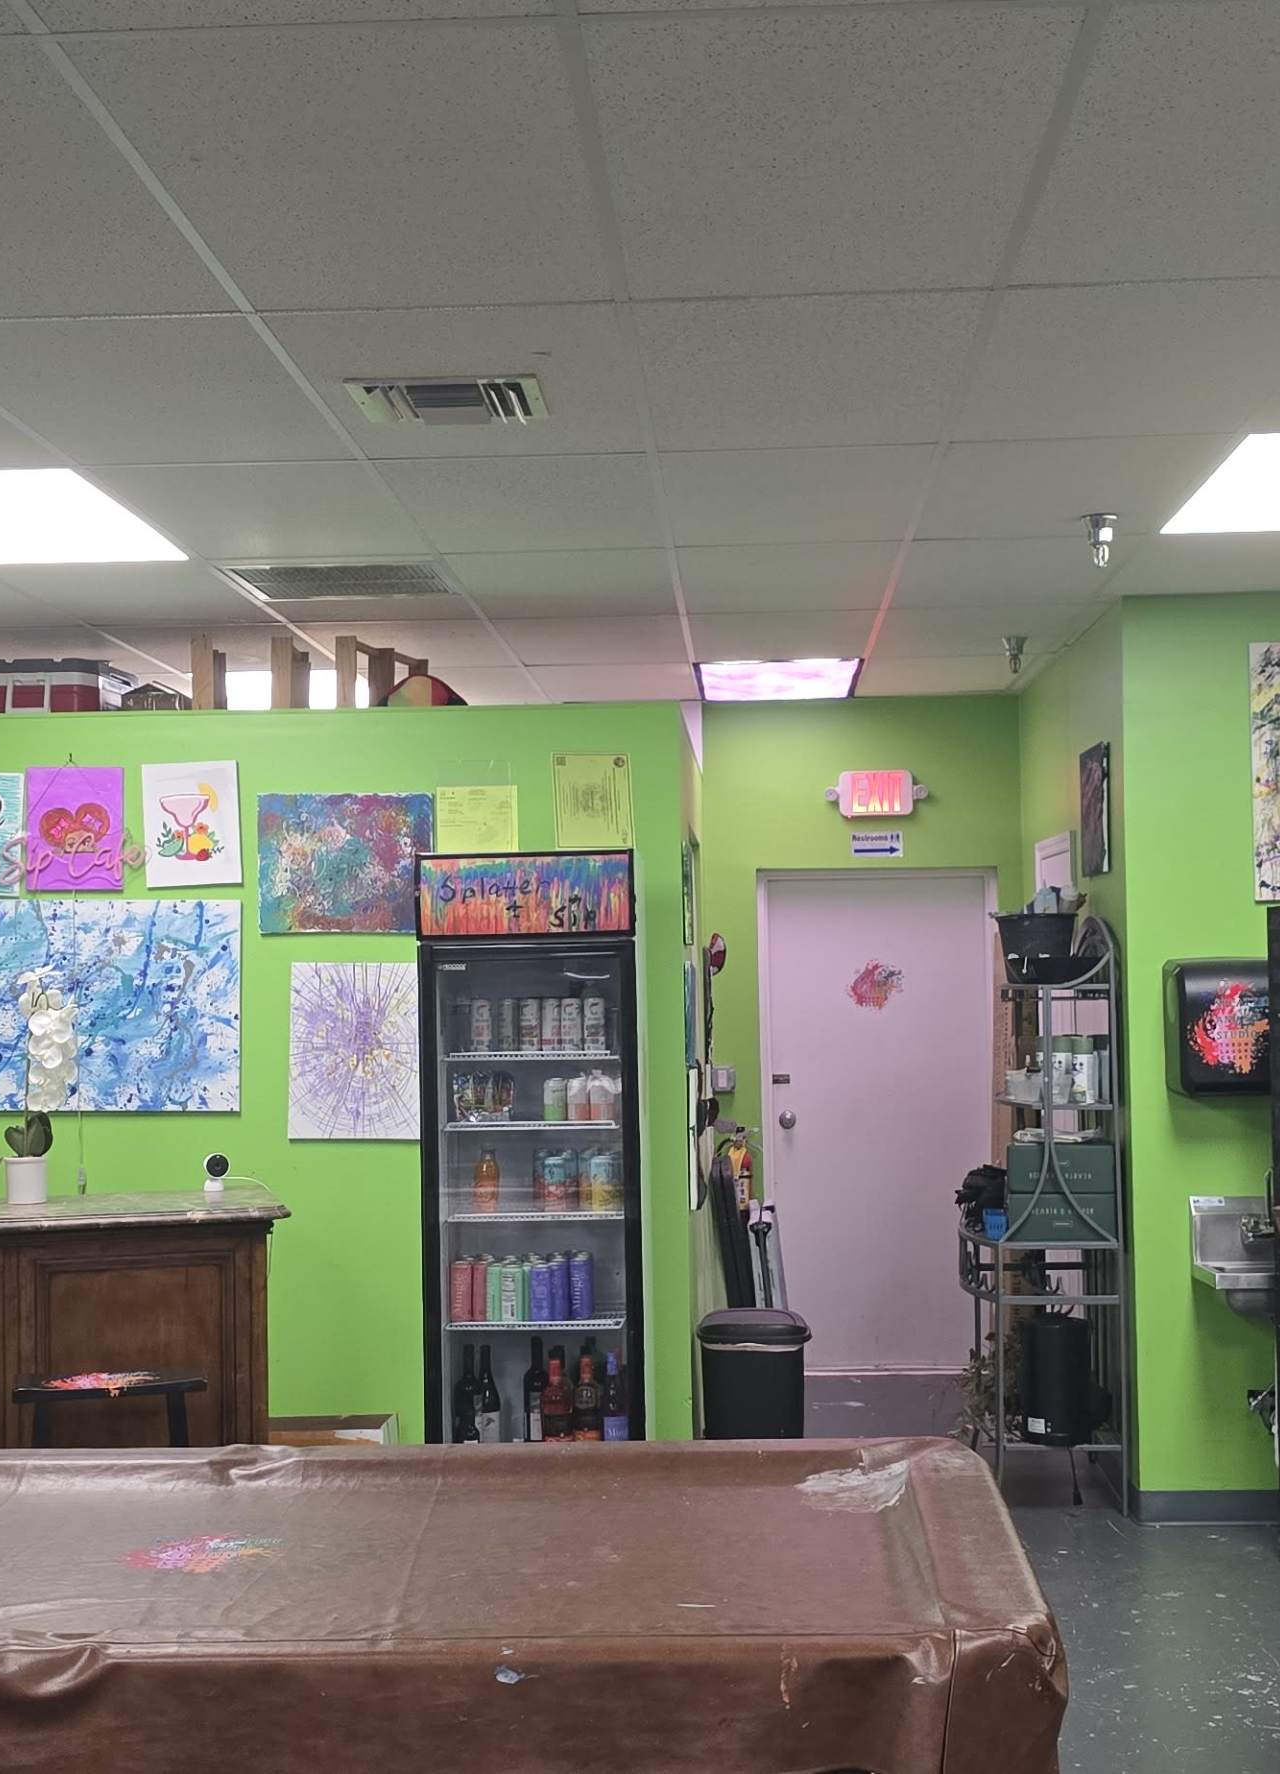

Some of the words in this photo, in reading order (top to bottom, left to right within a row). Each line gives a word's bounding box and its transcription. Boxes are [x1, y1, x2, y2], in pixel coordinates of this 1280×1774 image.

[852, 772, 903, 812] EXIT
[852, 833, 888, 842] Restrooms
[0, 833, 62, 891] Sip
[439, 873, 551, 905] Splatter
[572, 1271, 586, 1310] Mingle
